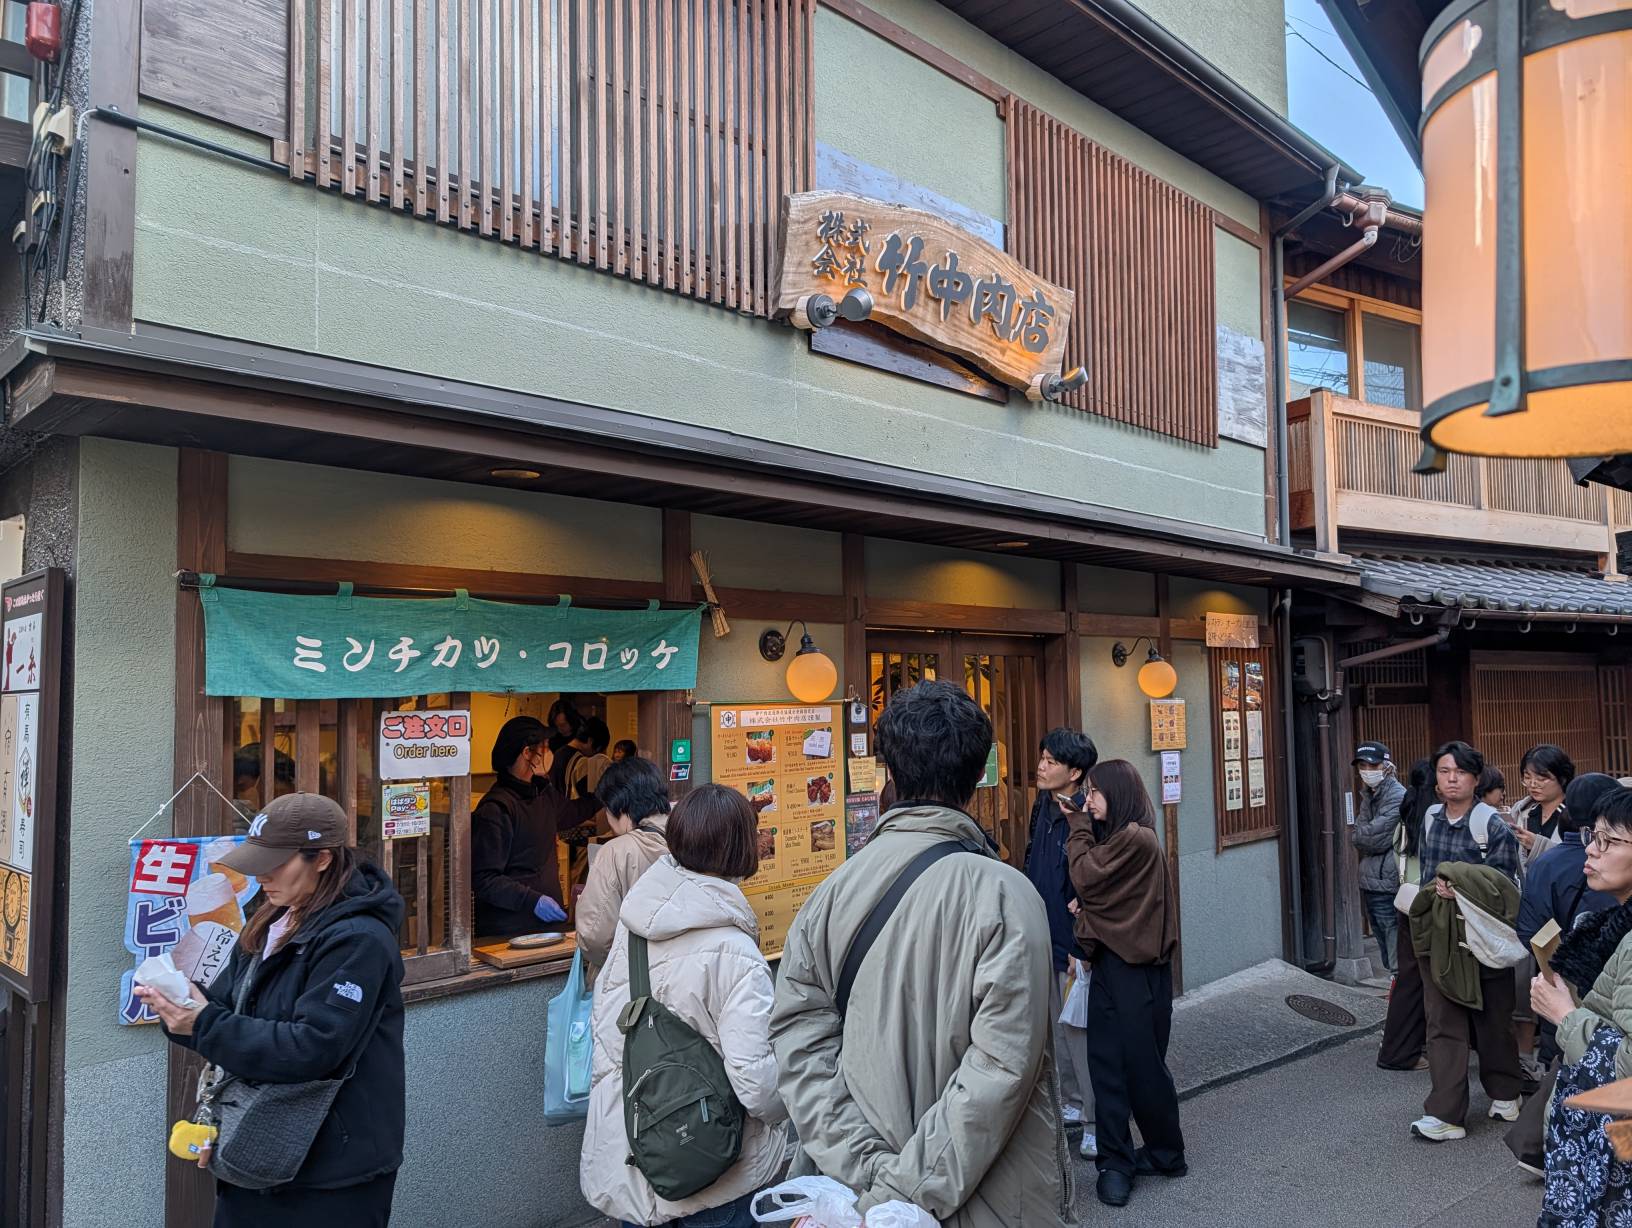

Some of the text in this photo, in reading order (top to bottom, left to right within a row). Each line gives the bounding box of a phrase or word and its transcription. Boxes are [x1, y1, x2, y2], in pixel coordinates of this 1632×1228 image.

[817, 210, 872, 256] 株式
[812, 243, 868, 287] 会社
[875, 232, 1055, 354] 竹中肉店
[293, 635, 679, 673] ミンチカツ・コロッケ
[382, 714, 467, 740] ご注文口
[394, 743, 458, 760] Order here
[200, 928, 235, 986] 冷えて
